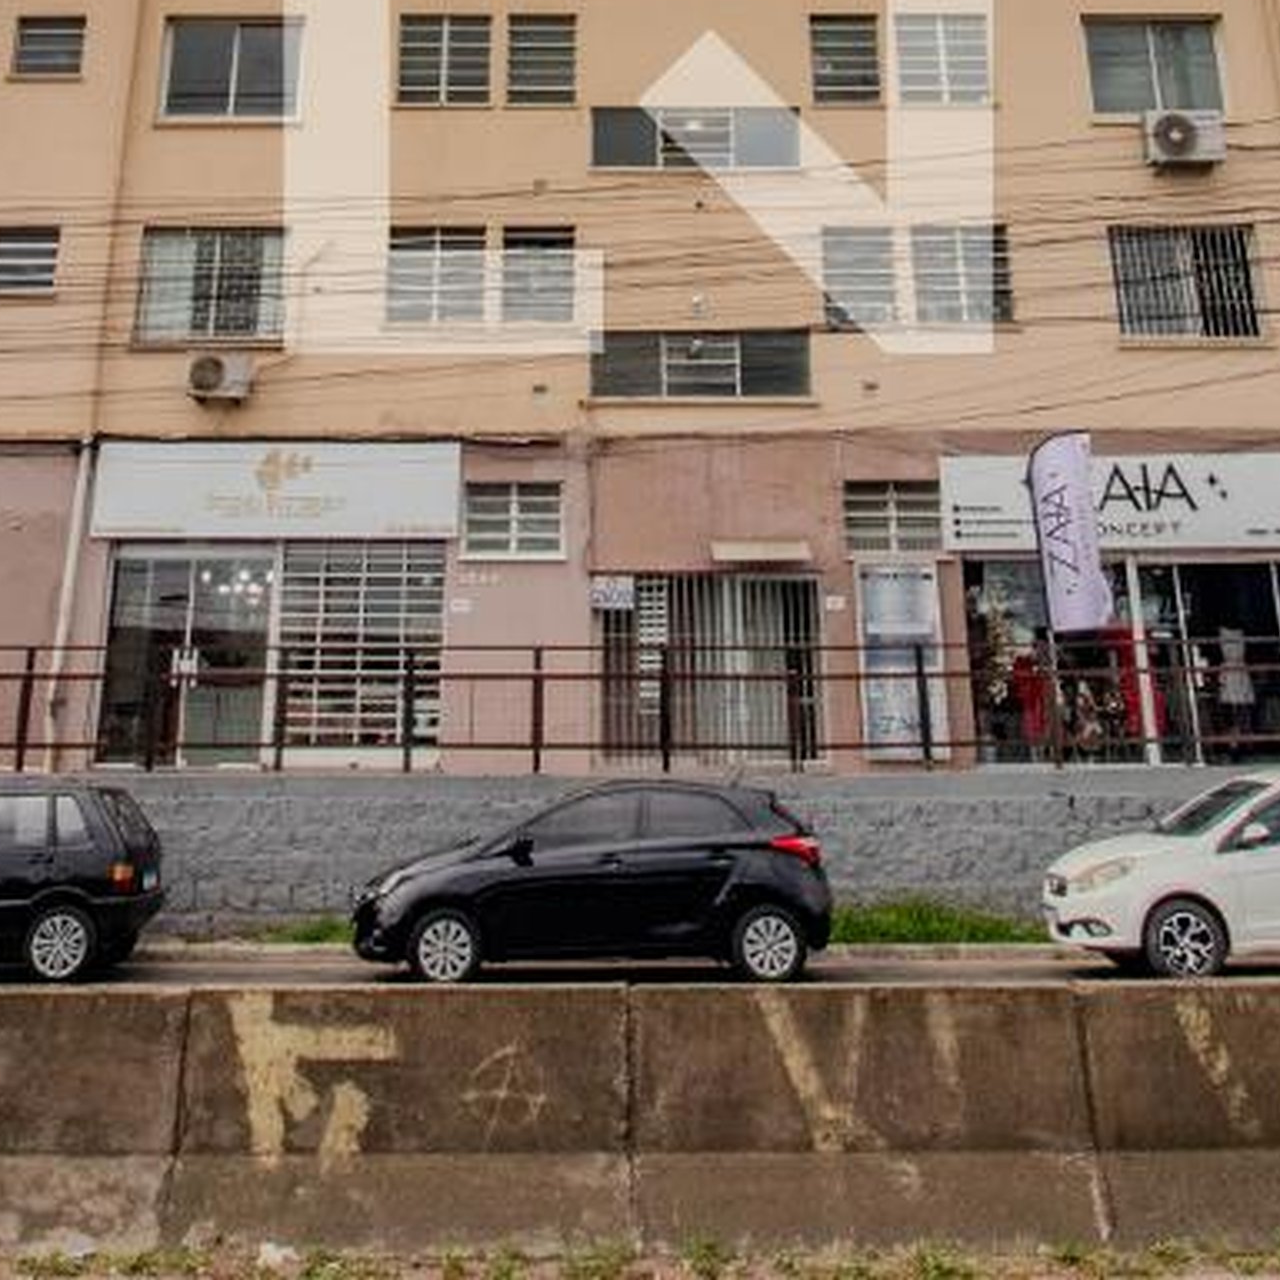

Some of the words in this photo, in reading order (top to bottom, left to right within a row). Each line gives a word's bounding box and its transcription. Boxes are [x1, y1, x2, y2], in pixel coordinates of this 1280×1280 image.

[1094, 461, 1199, 512] AIA
[1041, 483, 1081, 578] ZAIA
[1097, 522, 1182, 539] ONCEPT
